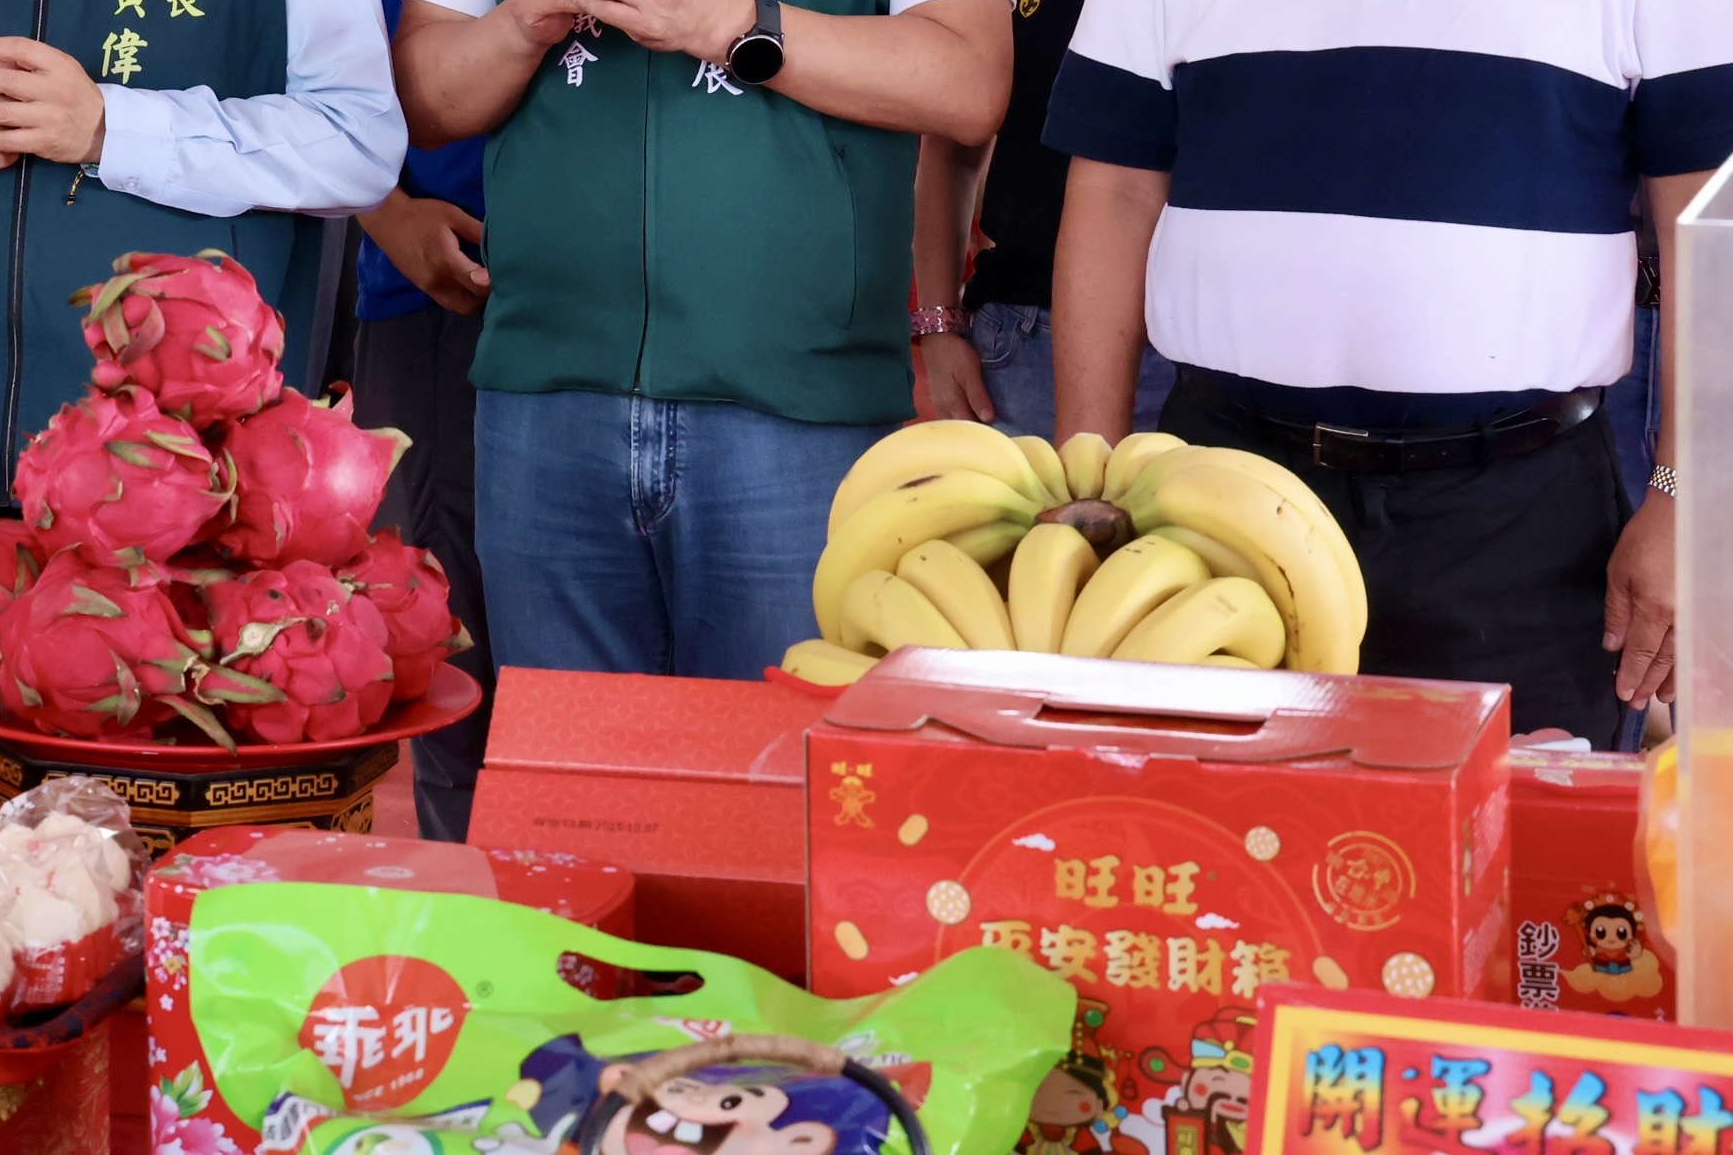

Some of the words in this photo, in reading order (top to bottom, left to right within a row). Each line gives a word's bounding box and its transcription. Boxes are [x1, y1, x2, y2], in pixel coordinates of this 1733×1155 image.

[1054, 854, 1200, 915] 旺旺
[1518, 919, 1560, 1011] 鈔票
[312, 1005, 456, 1089] 乖乖
